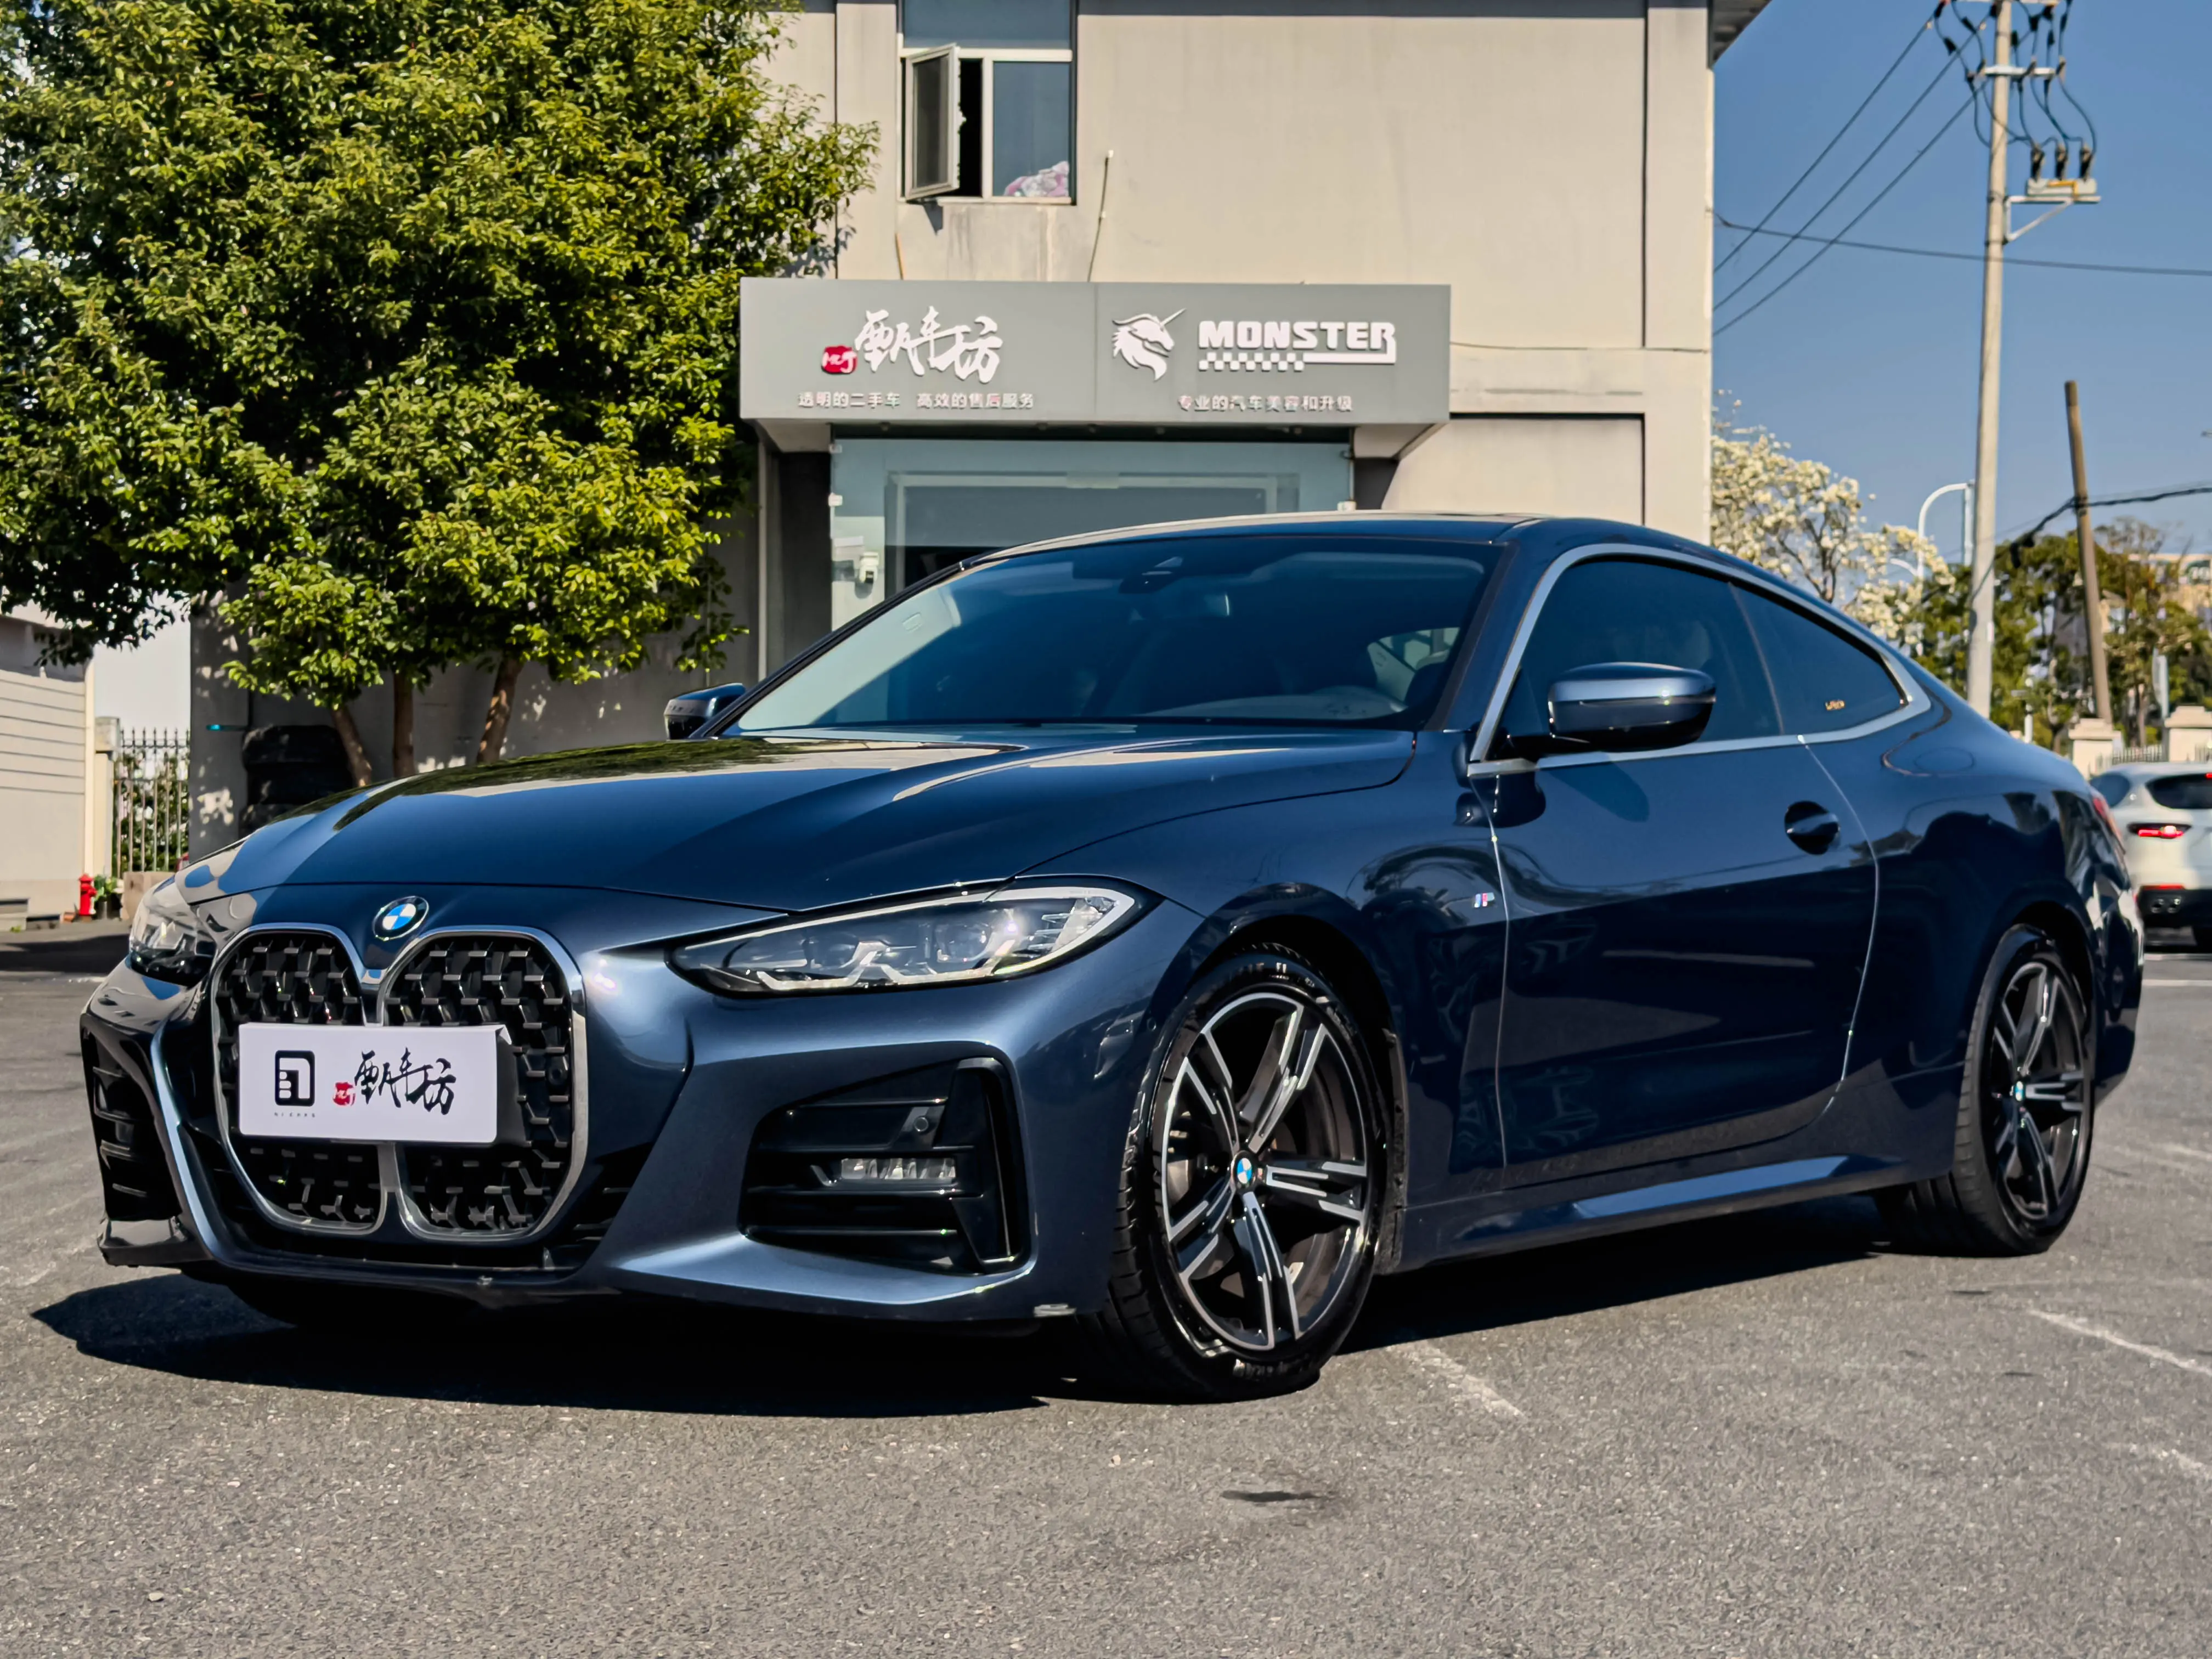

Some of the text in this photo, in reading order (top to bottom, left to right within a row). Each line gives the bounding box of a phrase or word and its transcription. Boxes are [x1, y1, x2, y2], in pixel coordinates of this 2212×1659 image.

[1199, 320, 1396, 364] MONSTER
[798, 391, 900, 409] 透明的二手车
[916, 392, 1034, 410] 高效的售后服务
[1177, 394, 1353, 412] 专业的汽车美容和升级
